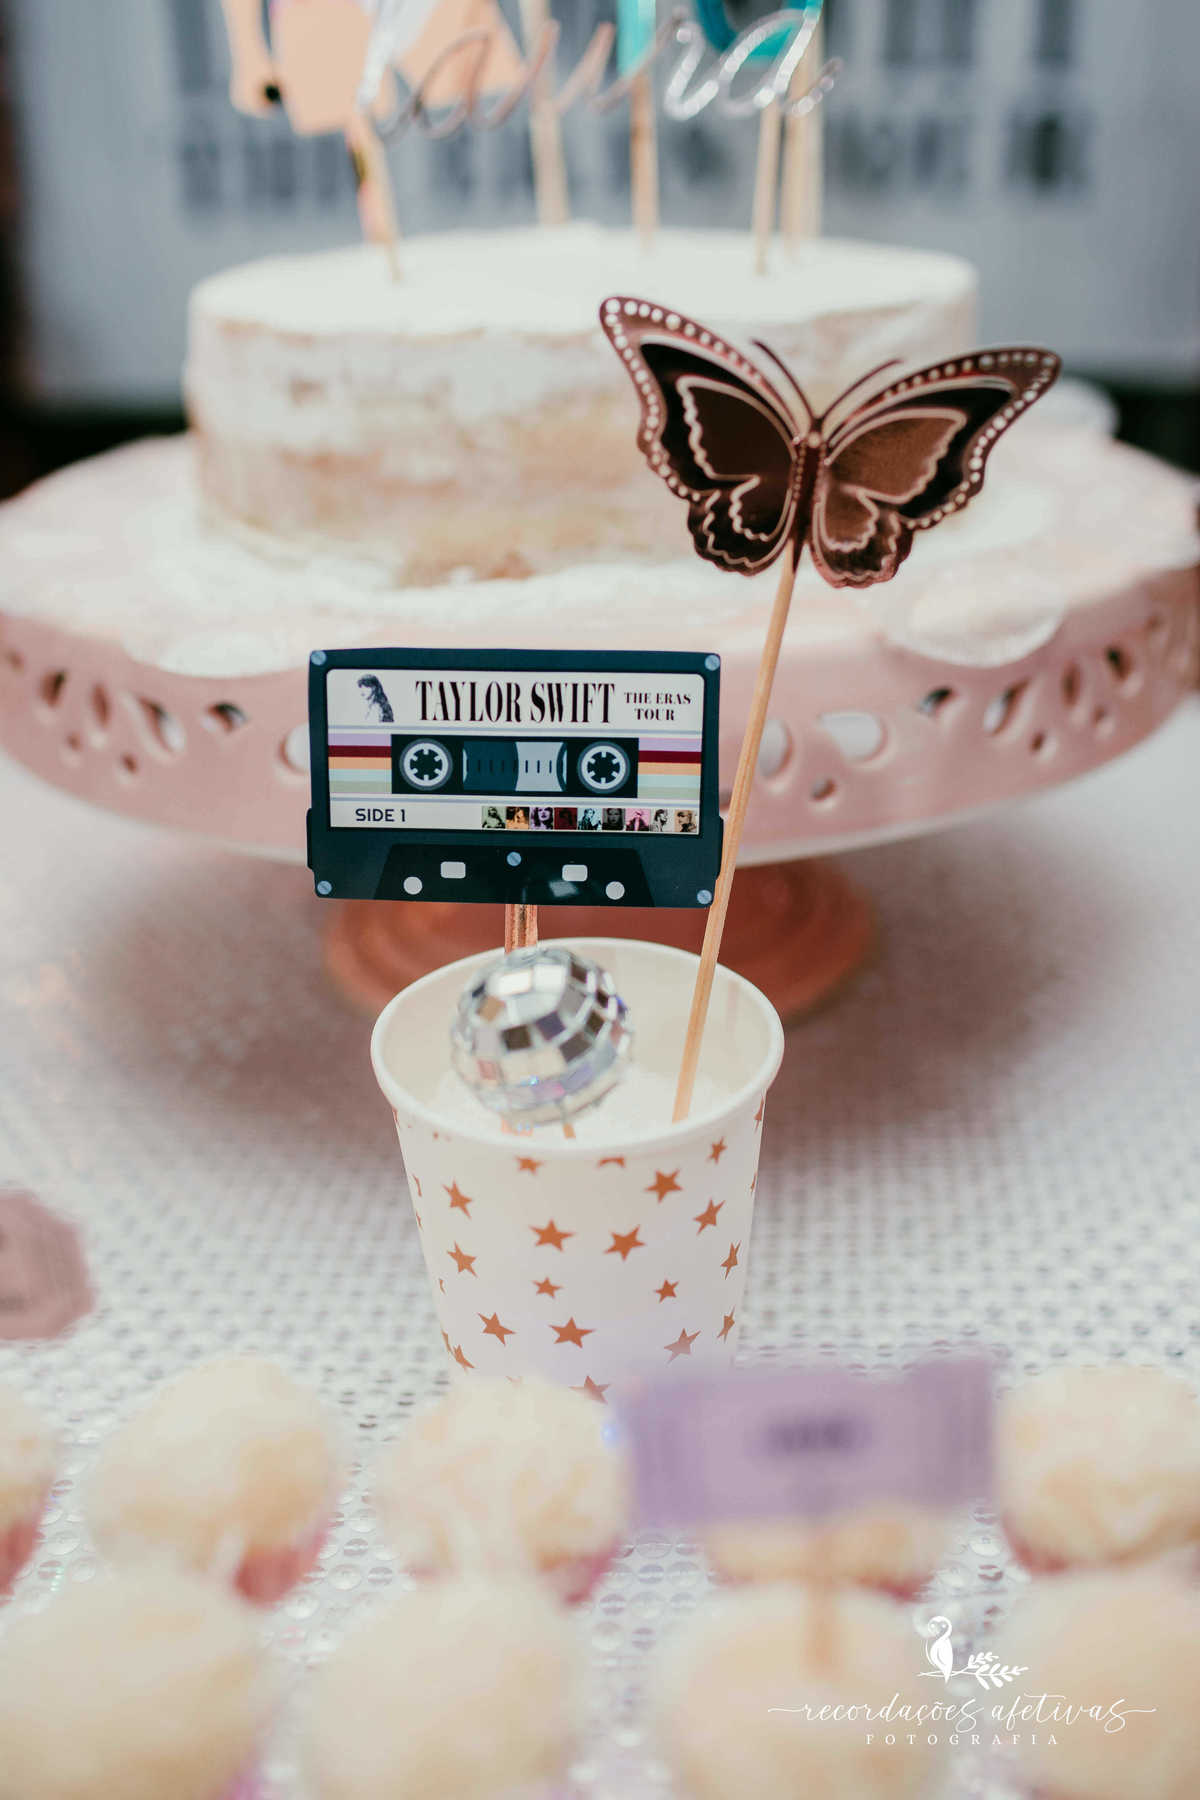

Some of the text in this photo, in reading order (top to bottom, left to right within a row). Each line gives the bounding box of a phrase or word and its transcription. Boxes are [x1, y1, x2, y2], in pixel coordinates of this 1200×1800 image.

[415, 680, 615, 723] TAYLOR SWIFT
[624, 691, 692, 705] THE ERAS
[634, 708, 675, 721] TOUR
[355, 808, 406, 823] SIDE 1
